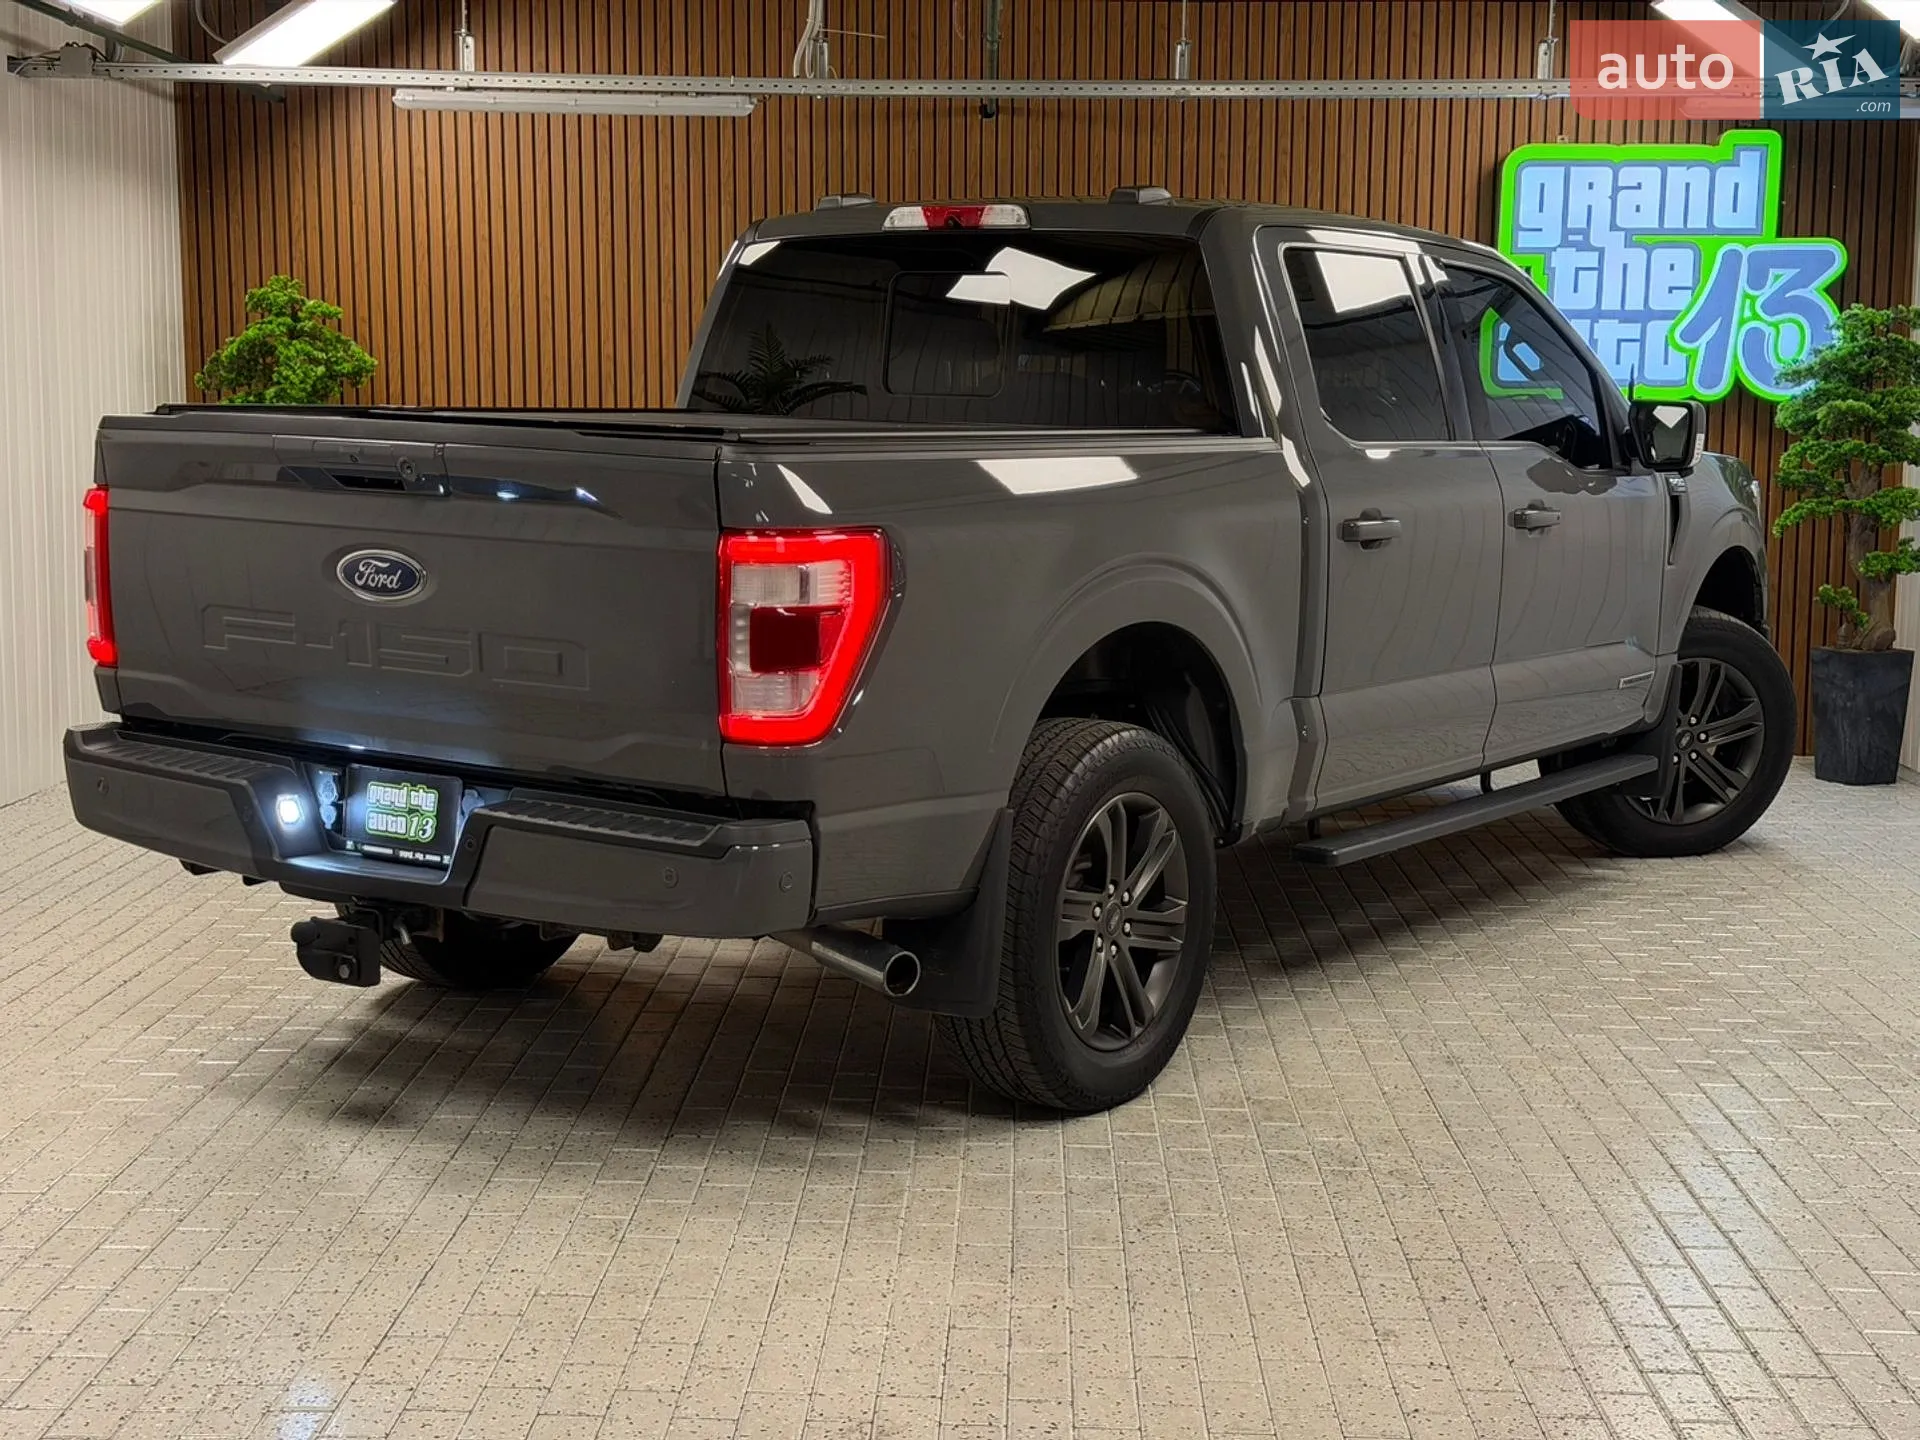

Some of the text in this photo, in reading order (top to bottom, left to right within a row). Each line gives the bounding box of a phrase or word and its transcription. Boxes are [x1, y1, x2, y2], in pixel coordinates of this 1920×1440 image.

[1551, 230, 1694, 310] the
[1674, 243, 1838, 396] 13
[354, 558, 401, 590] Ford
[202, 604, 589, 690] F-150
[367, 812, 434, 839] auto 13
[410, 788, 435, 812] the
